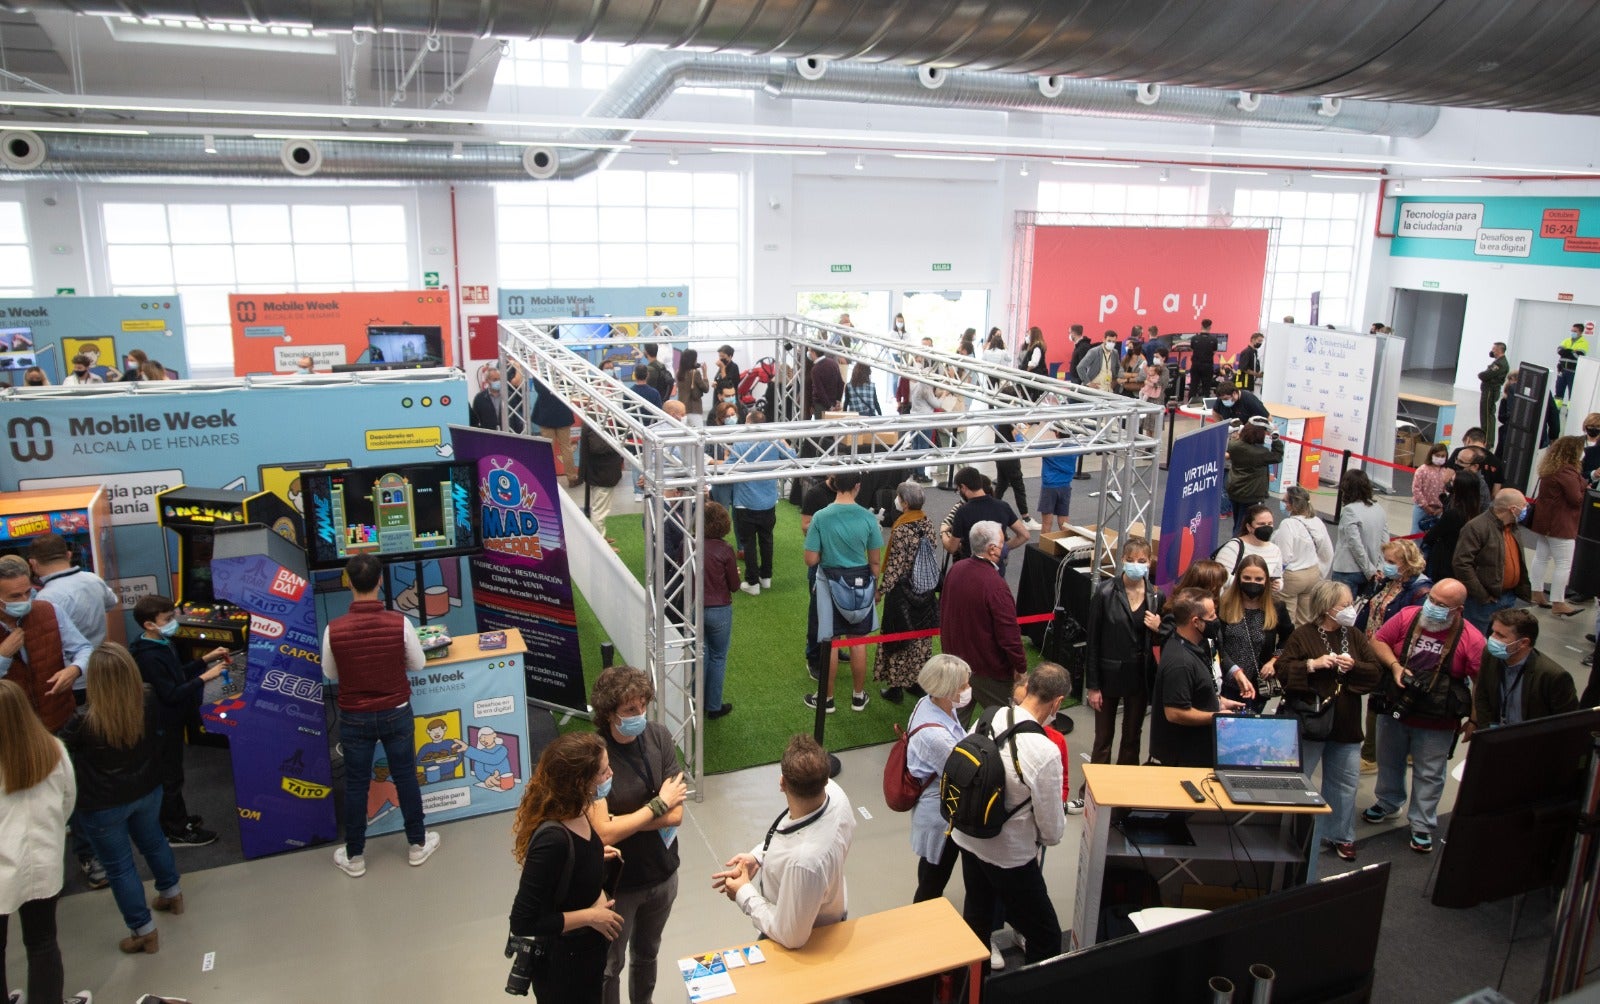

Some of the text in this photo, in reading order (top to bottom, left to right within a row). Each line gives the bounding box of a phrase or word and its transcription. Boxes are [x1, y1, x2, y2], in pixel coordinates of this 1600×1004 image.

[1405, 209, 1477, 222] Tecnología para
[1403, 220, 1463, 232] la ciudadanía
[1545, 224, 1574, 234] 16-24
[1481, 233, 1514, 242] Desafíos
[1501, 243, 1526, 253] digital
[264, 300, 339, 311] Mobile Week
[530, 294, 595, 305] Mobile Week
[8, 306, 48, 318] Week
[322, 350, 339, 358] para
[68, 408, 237, 438] Mobile Week
[72, 432, 240, 455] ALCALÁ DE HENARES
[1184, 460, 1218, 483] VIRTUAL
[107, 483, 169, 501] gía para
[1182, 474, 1218, 499] REALITY
[109, 501, 149, 515] anía
[11, 520, 50, 538] JUNIOR
[481, 505, 540, 539] MAD
[483, 536, 543, 560] ARCADE
[278, 569, 306, 587] BAN
[492, 574, 544, 591] COMPRA VENTA
[515, 569, 563, 585] RESTAURACIÓN
[134, 582, 148, 592] en
[272, 580, 298, 596] DAI
[249, 594, 288, 613] TAITO
[252, 621, 278, 634] ndo
[428, 669, 464, 684] Week
[525, 664, 568, 680] -arcade.com
[261, 669, 323, 705] SEGA
[430, 682, 466, 694] HENARES
[288, 782, 323, 797] TAITO
[450, 791, 465, 800] para
